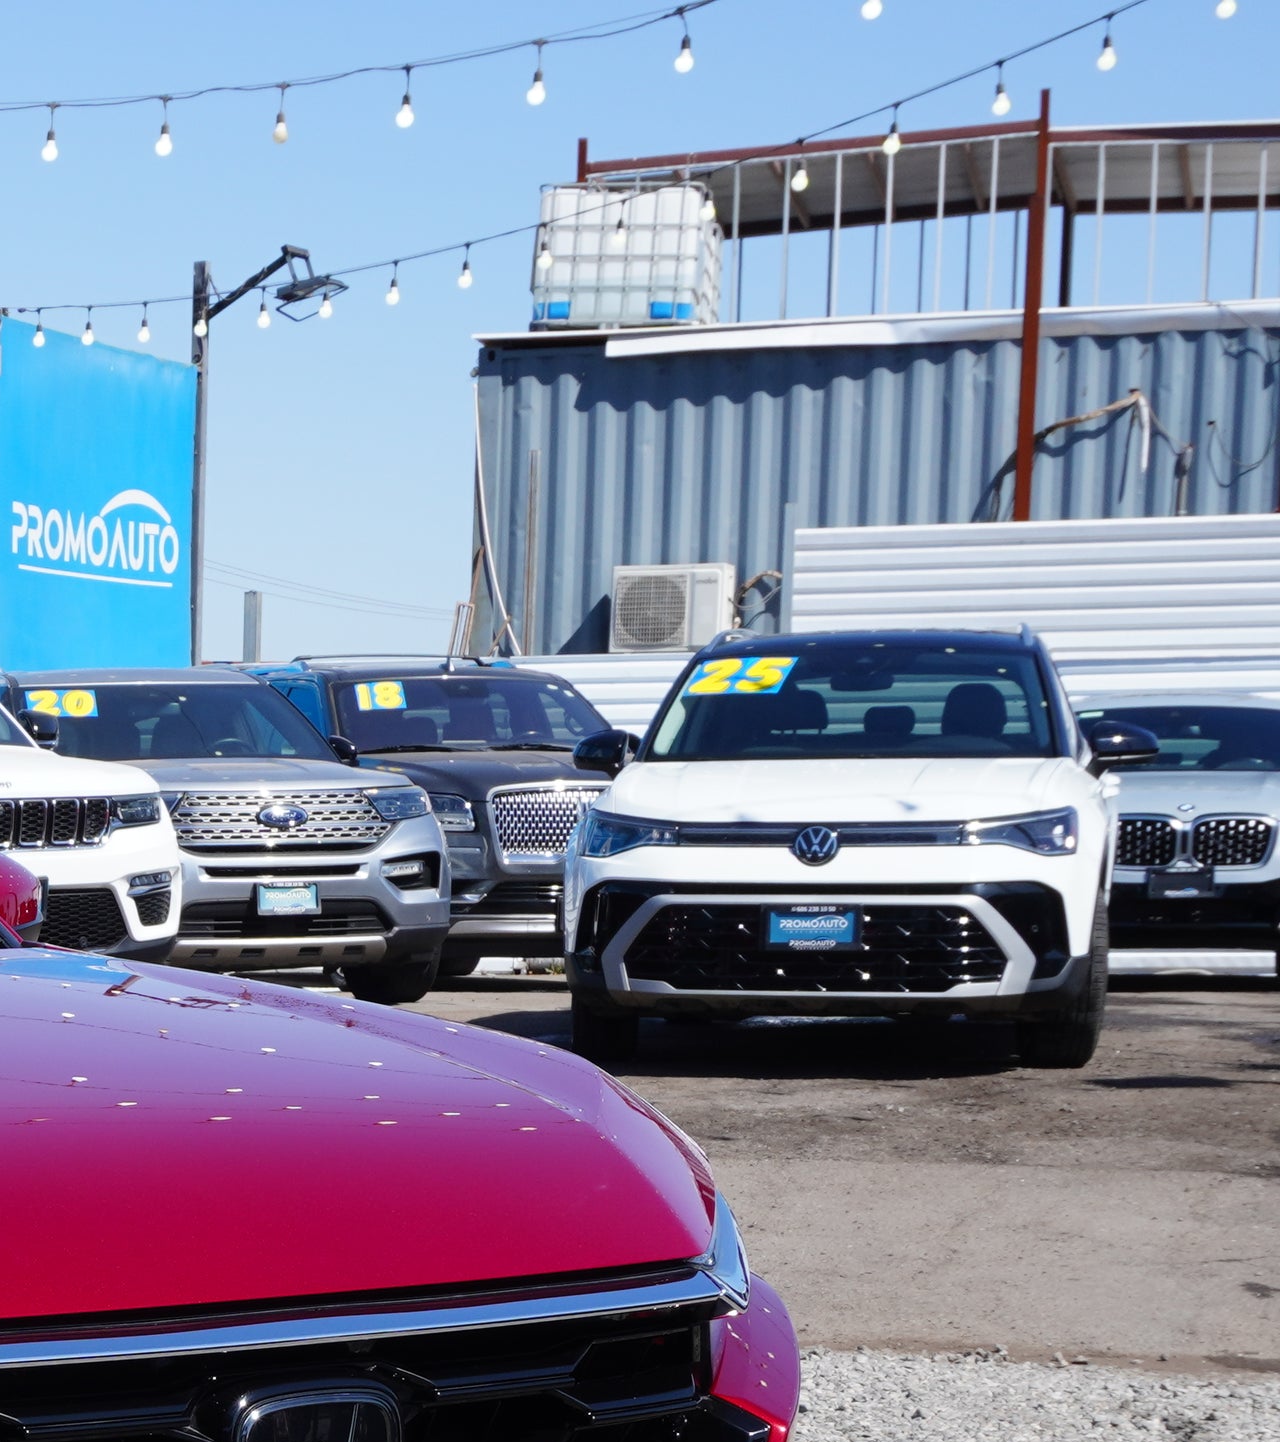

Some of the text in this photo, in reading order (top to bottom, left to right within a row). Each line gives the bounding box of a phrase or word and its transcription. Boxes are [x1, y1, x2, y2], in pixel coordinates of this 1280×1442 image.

[11, 500, 180, 575] PROMOAUTO
[688, 657, 794, 694] 25
[28, 690, 95, 717] 20
[357, 681, 403, 711] 18
[780, 919, 848, 928] PROMOAUTO
